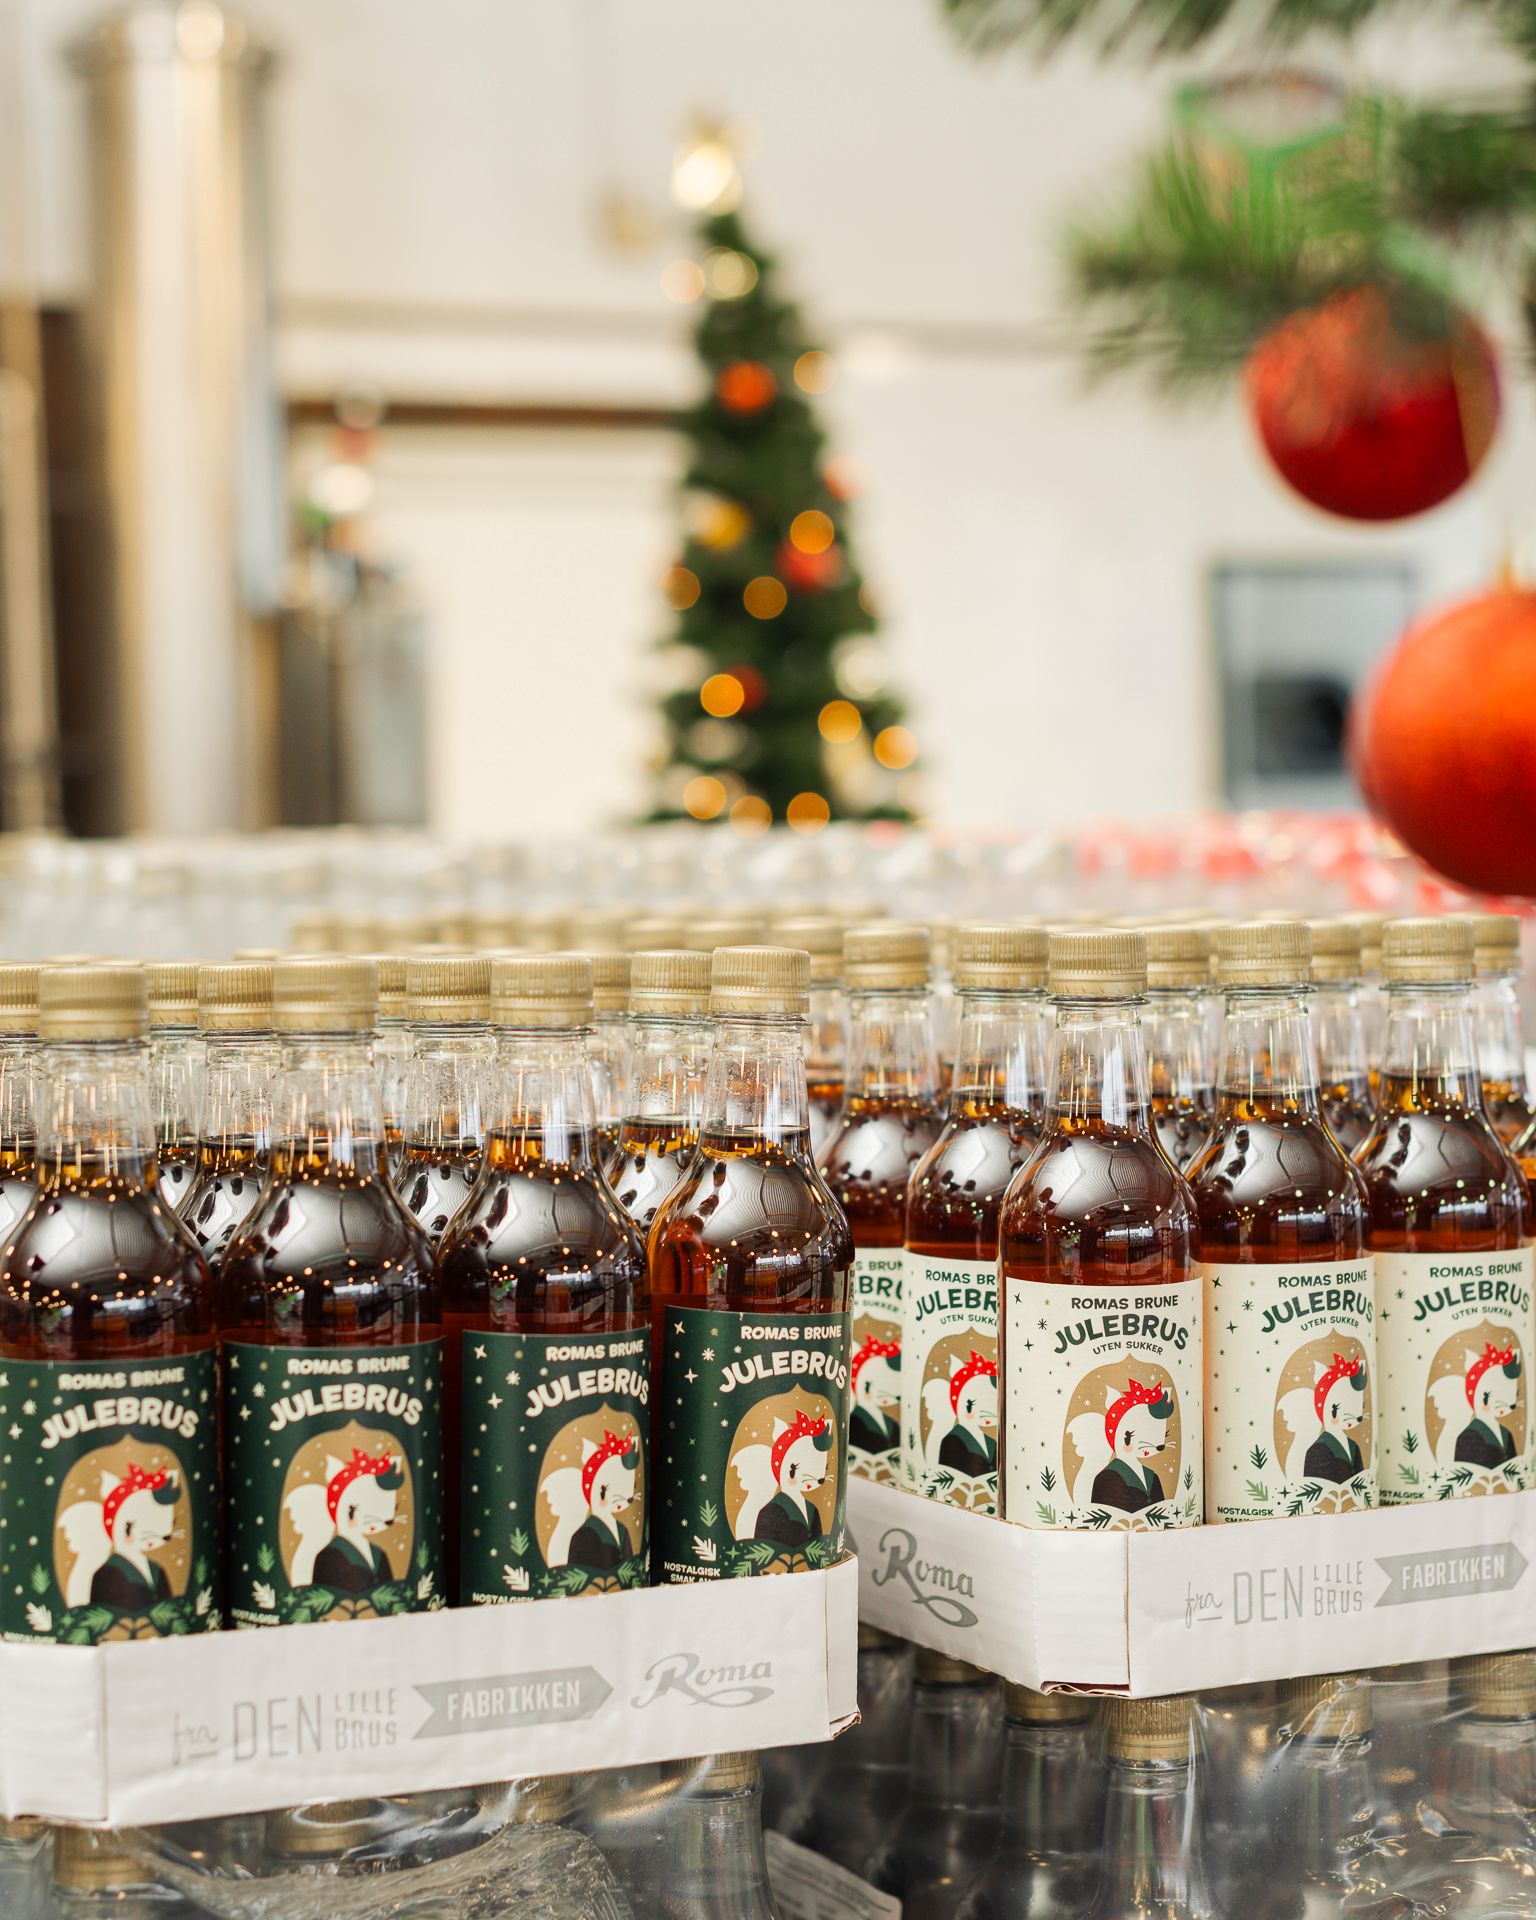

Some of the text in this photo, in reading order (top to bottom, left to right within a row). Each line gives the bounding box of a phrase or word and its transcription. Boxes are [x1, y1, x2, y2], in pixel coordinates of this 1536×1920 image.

[925, 1269, 971, 1284] ROMAS
[1278, 1270, 1367, 1288] ROMAS BRUNE
[1429, 1261, 1523, 1278] ROMAS BRUNE
[915, 1288, 997, 1322] JULEBR
[1071, 1295, 1179, 1310] ROMAS BRUNE
[1261, 1289, 1374, 1333] JULEBRUS
[1413, 1280, 1530, 1321] JULEBRUS
[1452, 1306, 1513, 1321] UTEN SUKKER
[741, 1324, 842, 1340] ROMAS BRUNE
[940, 1314, 997, 1327] UTEN SUKK
[1054, 1313, 1189, 1354] JULEBRUS
[1300, 1316, 1359, 1331] UTEN SUKKER
[546, 1339, 644, 1361] ROMAS BRUNE
[1092, 1341, 1164, 1356] UTEN SUKKER
[58, 1367, 185, 1390] ROMAS BRUNE
[287, 1355, 411, 1375] ROMAS BRUNE
[719, 1350, 848, 1393] JULEBRUS
[525, 1368, 649, 1417] JULEBRUS
[269, 1383, 423, 1431] JULEBRUS
[41, 1397, 200, 1449] JULEBRUS
[1217, 1506, 1274, 1516] NOSTALGISK
[664, 1561, 721, 1577] NOSTALGISK
[872, 1528, 979, 1627] Roma
[1314, 1561, 1363, 1585] LILLE
[1402, 1555, 1505, 1590] FABRIKKEN
[1185, 1565, 1303, 1628] fra DEN
[1314, 1587, 1363, 1616] BRUS
[630, 1652, 775, 1708] Roma
[335, 1688, 397, 1715] LILLE
[447, 1680, 580, 1721] FABRIKKEN
[233, 1694, 322, 1762] DEN
[335, 1717, 397, 1751] BRUS
